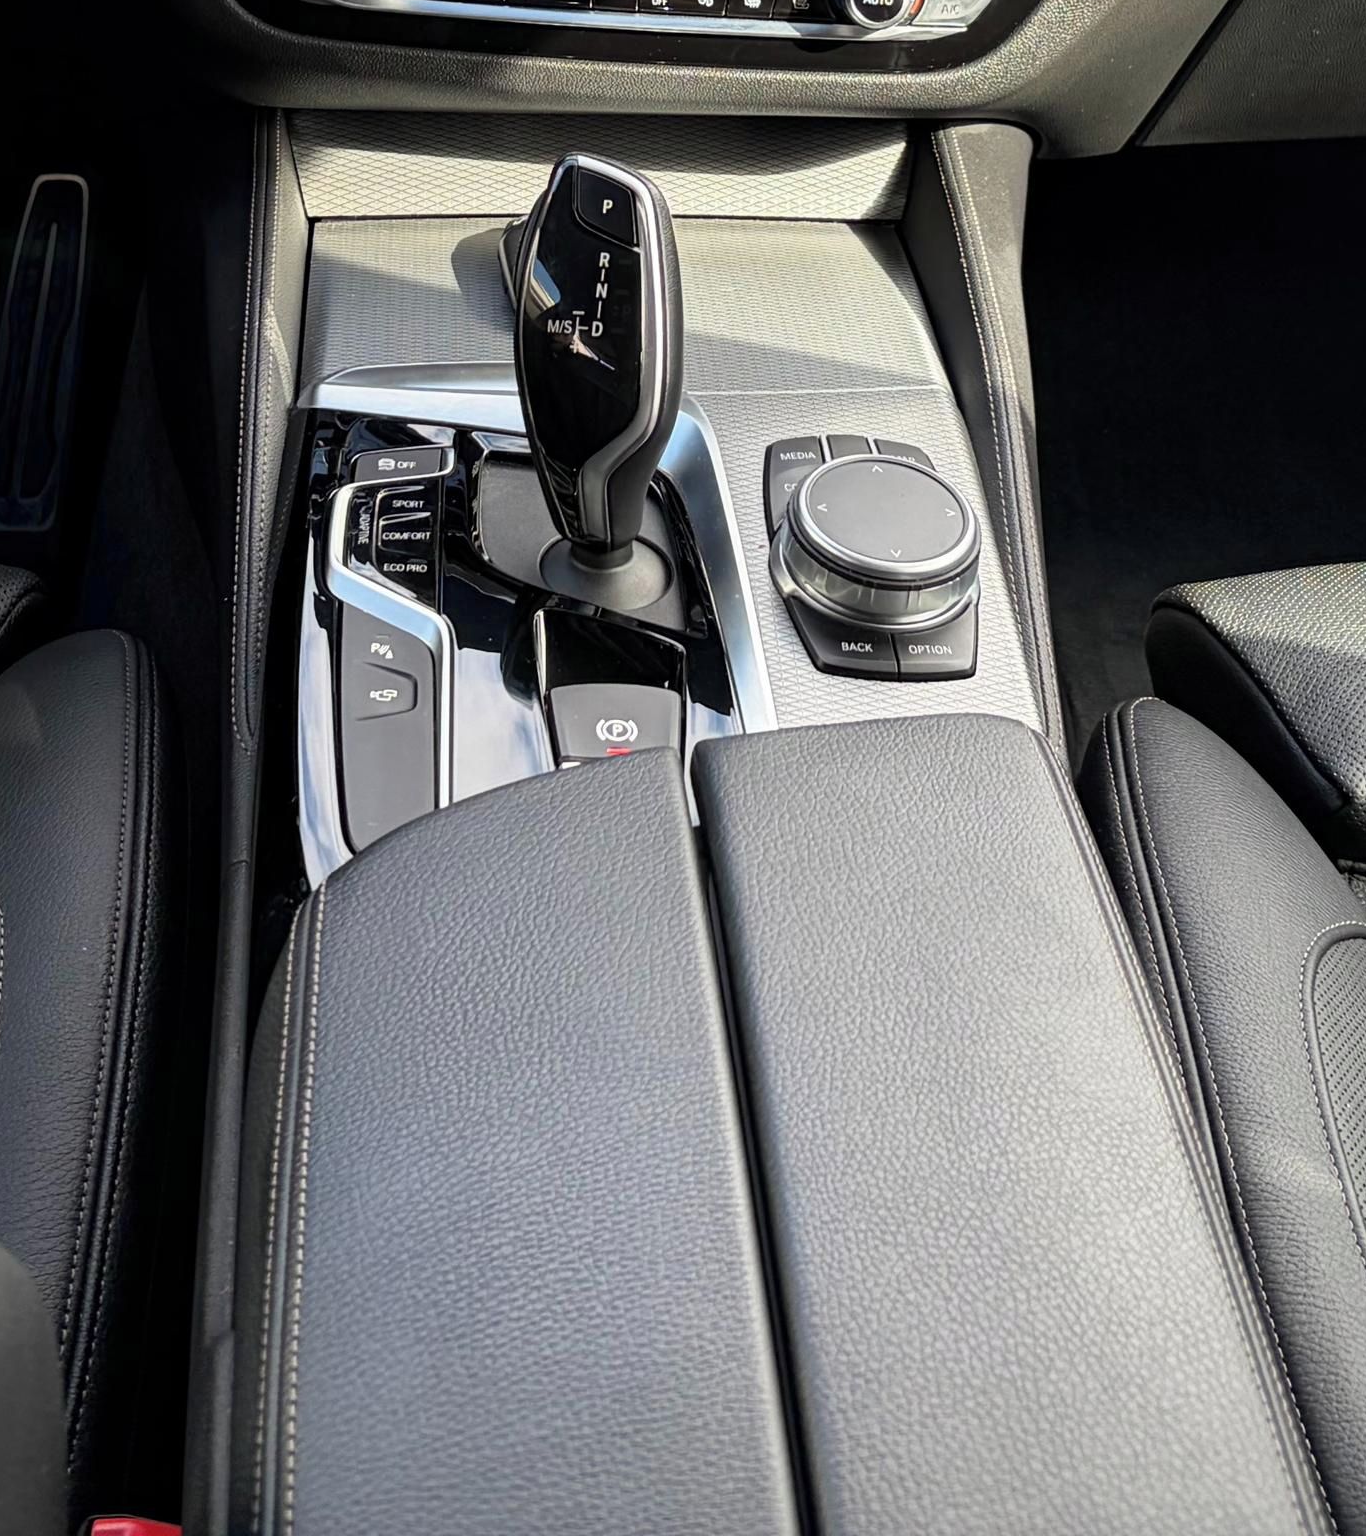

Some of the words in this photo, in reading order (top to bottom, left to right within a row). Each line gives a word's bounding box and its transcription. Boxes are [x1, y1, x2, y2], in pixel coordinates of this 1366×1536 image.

[941, 4, 960, 16] A/C
[601, 198, 614, 215] P
[598, 251, 611, 268] R
[595, 282, 609, 300] N
[546, 318, 573, 335] M/S
[590, 320, 604, 338] D
[779, 450, 817, 461] MEDIA
[396, 460, 417, 470] OFF
[391, 499, 426, 509] SPORT
[381, 531, 432, 541] COMFORT
[382, 562, 406, 572] ECO
[406, 563, 428, 574] PRO
[840, 641, 874, 653] BACK
[908, 644, 954, 656] OPTION
